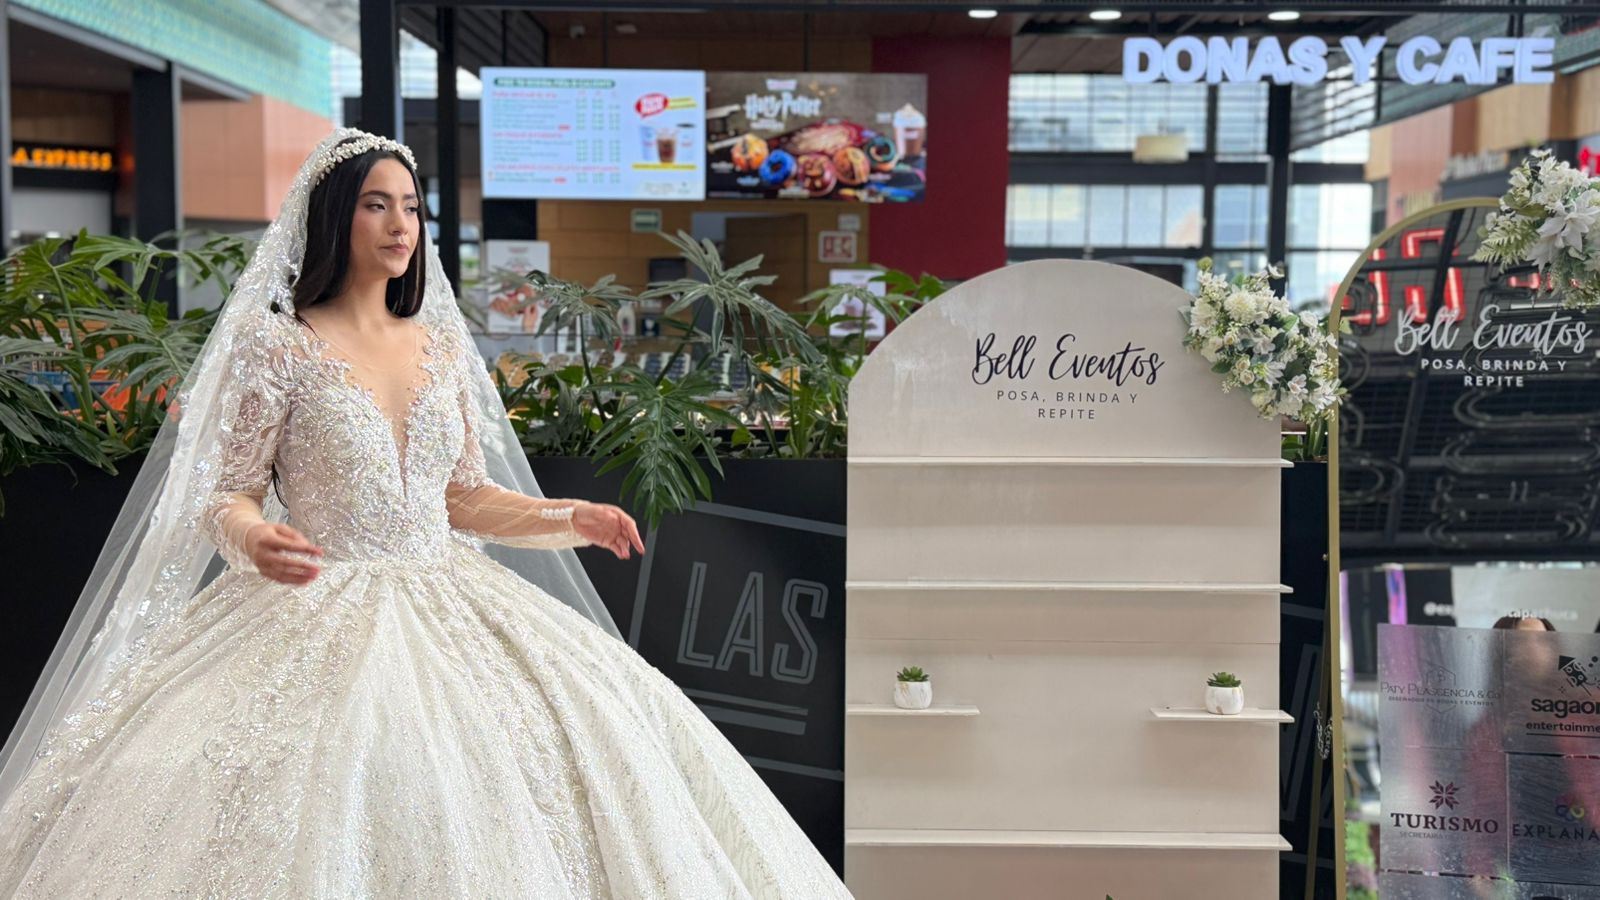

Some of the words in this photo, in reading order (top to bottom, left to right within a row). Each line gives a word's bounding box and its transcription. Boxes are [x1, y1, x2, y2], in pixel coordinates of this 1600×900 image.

[1122, 36, 1328, 85] DONAS
[1340, 36, 1388, 84] Y
[1396, 36, 1556, 85] CAFE
[1394, 306, 1460, 355] Bell
[1473, 304, 1593, 355] Eventos
[972, 332, 1037, 385] Bell
[1048, 333, 1165, 387] Eventos
[1421, 359, 1471, 371] POSA,
[1482, 359, 1548, 371] BRINDA
[1557, 361, 1567, 371] Y
[1464, 375, 1525, 388] REPITE
[997, 390, 1046, 403] POSA,
[1056, 391, 1120, 403] BRINDA
[1130, 393, 1138, 404] Y
[1038, 408, 1096, 420] REPITE
[676, 561, 829, 685] LAS
[1380, 681, 1405, 694] PATY
[1477, 690, 1485, 699] &
[1391, 812, 1499, 834] TURISMO
[1512, 823, 1600, 841] EXPLANA
